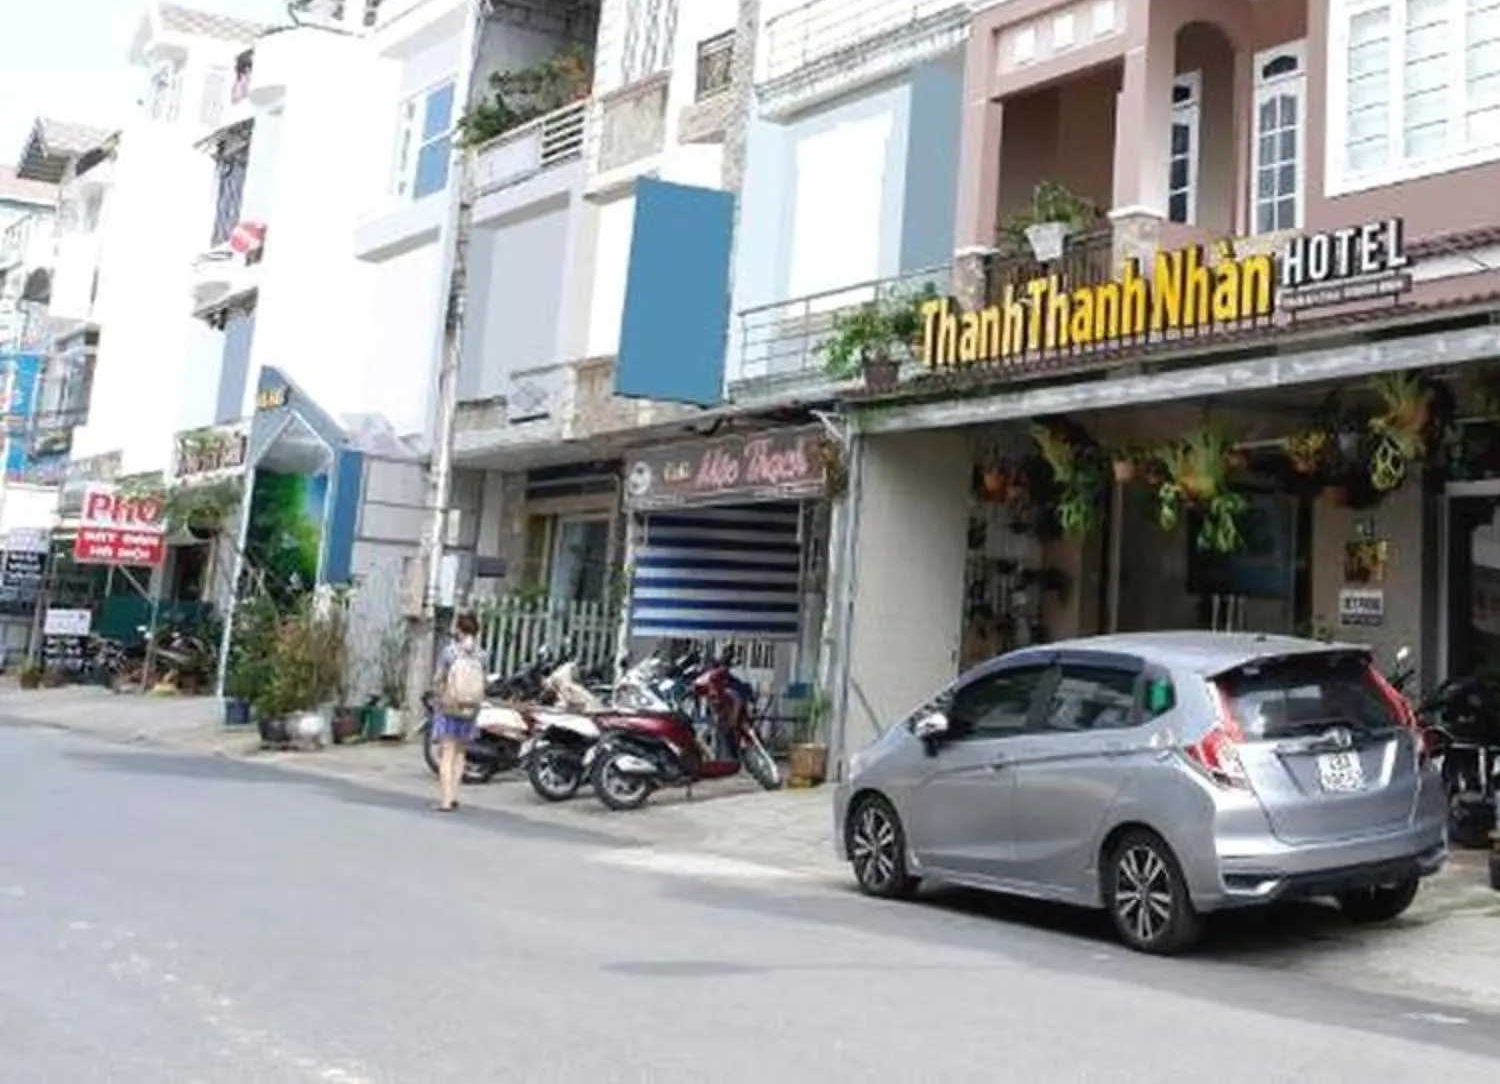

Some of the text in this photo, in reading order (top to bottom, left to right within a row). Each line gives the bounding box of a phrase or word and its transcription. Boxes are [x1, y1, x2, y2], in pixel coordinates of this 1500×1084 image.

[921, 218, 1410, 368] Thanh Thanh Nhàn HOTEL
